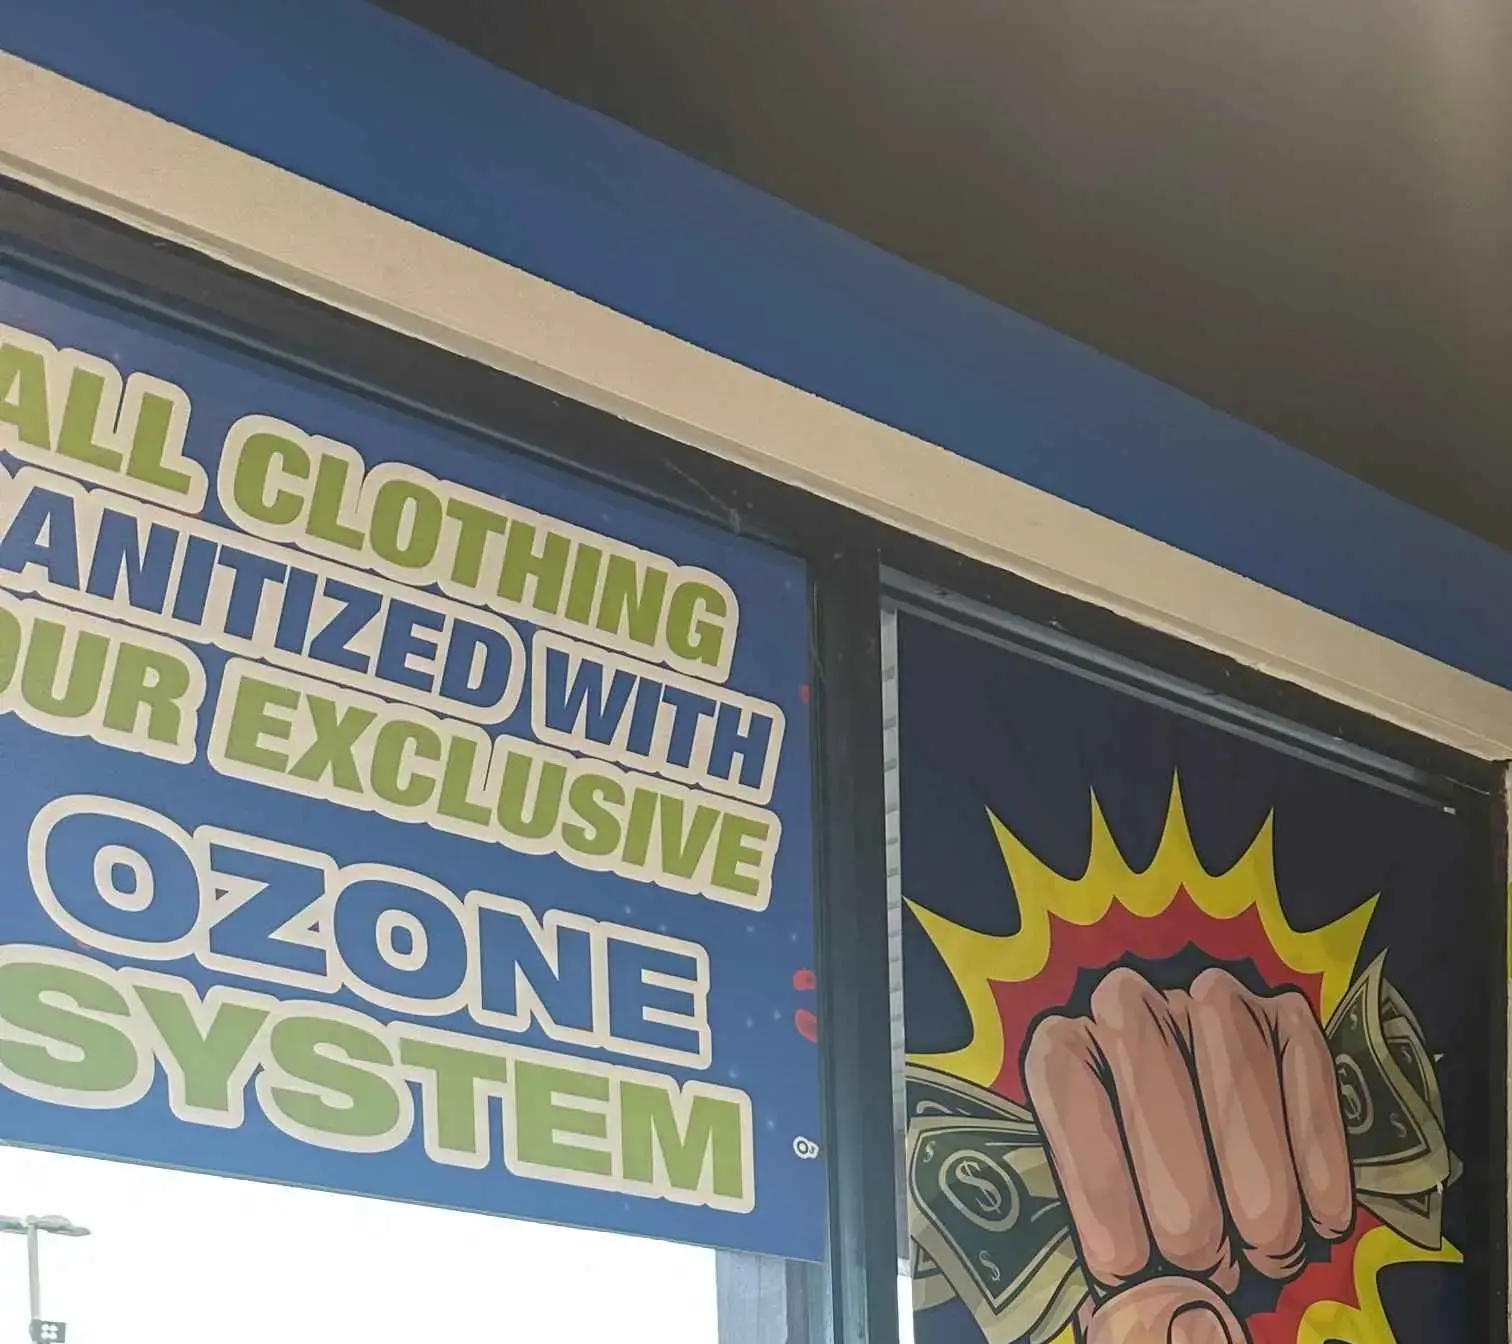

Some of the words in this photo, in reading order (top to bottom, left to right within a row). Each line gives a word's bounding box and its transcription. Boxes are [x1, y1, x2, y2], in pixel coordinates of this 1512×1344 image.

[0, 342, 192, 495] ALL
[230, 432, 729, 668] CLOTHING
[0, 486, 513, 710] ANITIZED
[543, 647, 773, 789] WITH
[222, 676, 770, 897] EXCLUSIVE
[44, 811, 701, 1055] OZONE
[0, 962, 745, 1199] SYSTEM
